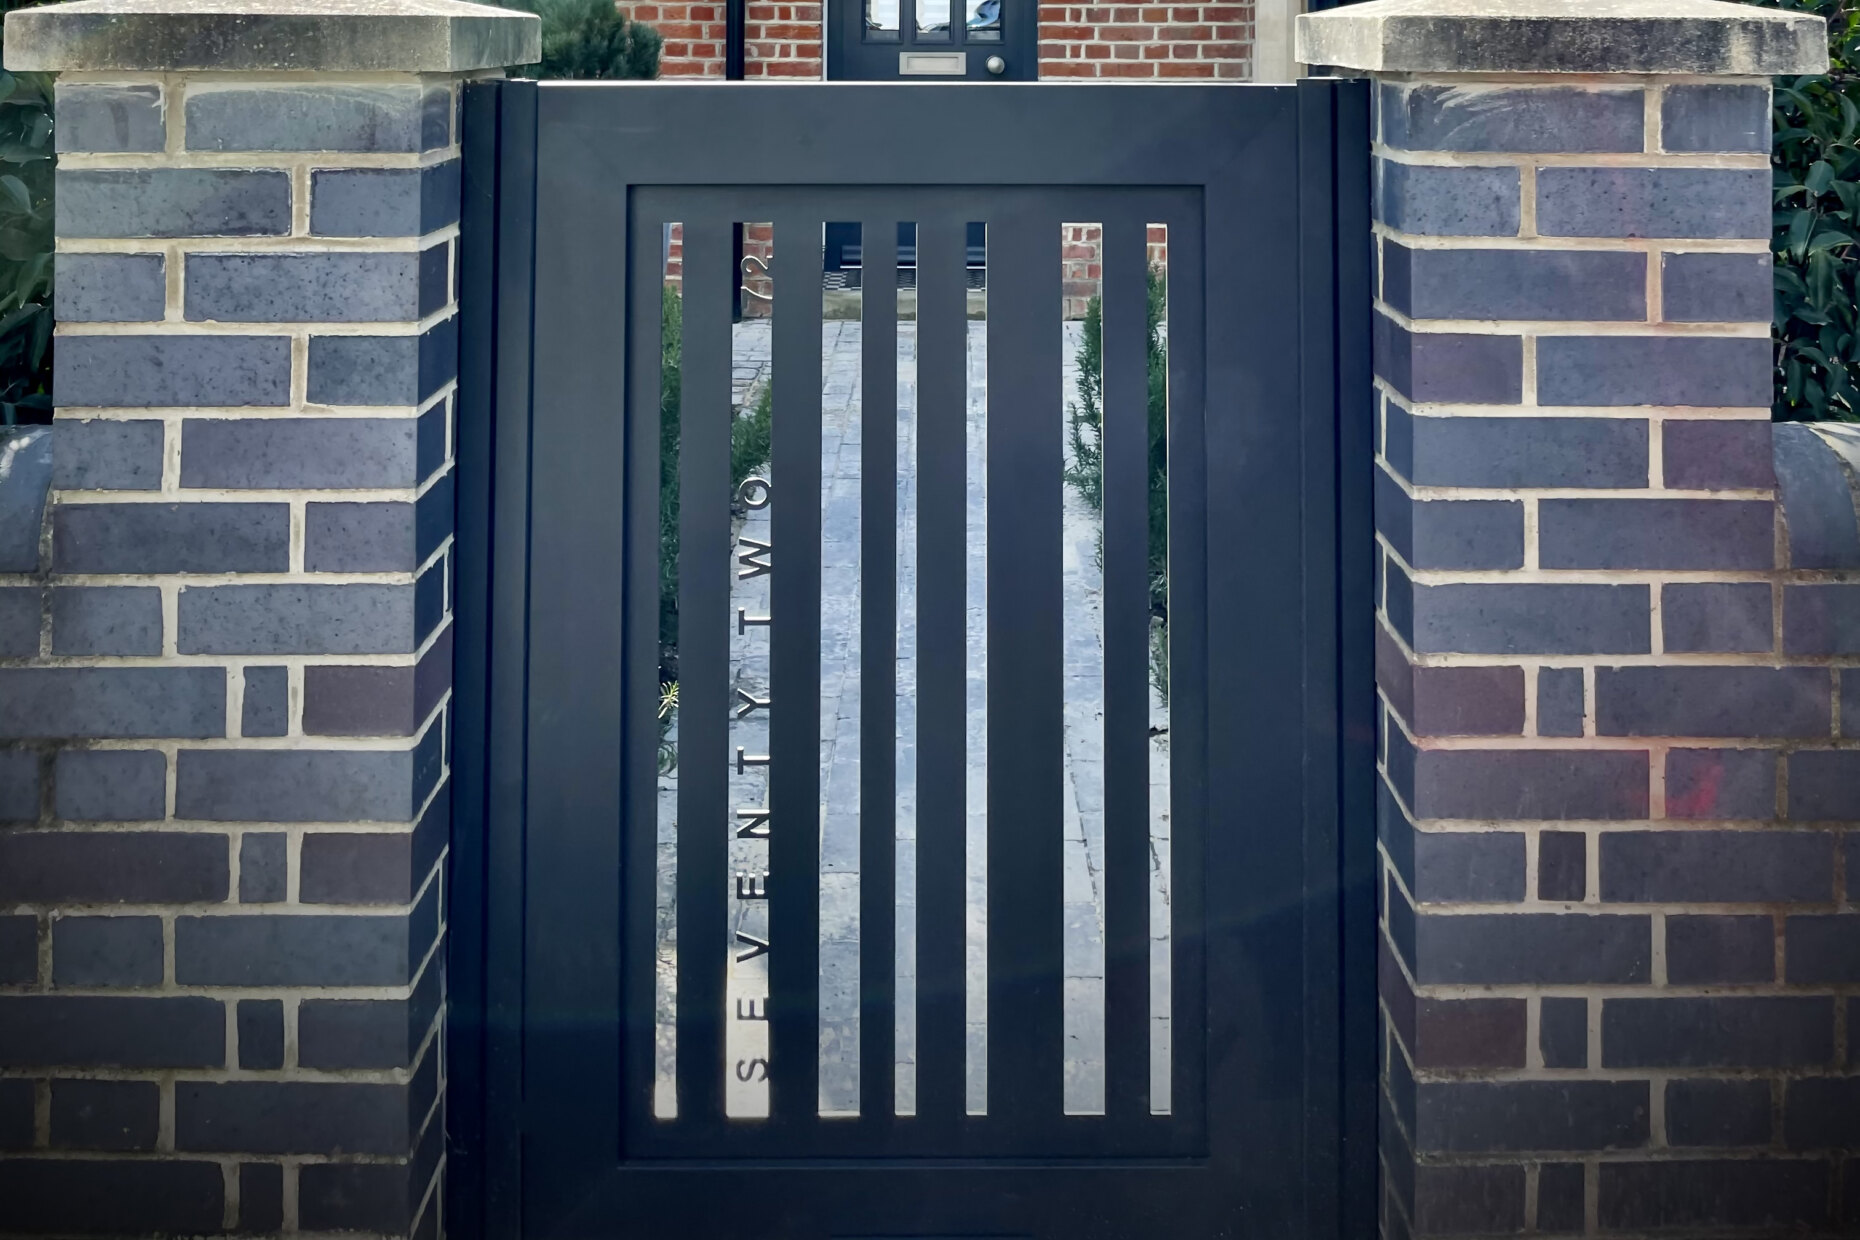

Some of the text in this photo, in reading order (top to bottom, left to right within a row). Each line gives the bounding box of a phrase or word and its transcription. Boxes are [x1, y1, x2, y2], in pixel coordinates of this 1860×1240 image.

[740, 255, 773, 310] 72
[736, 476, 771, 1083] SEVENTY TWO
